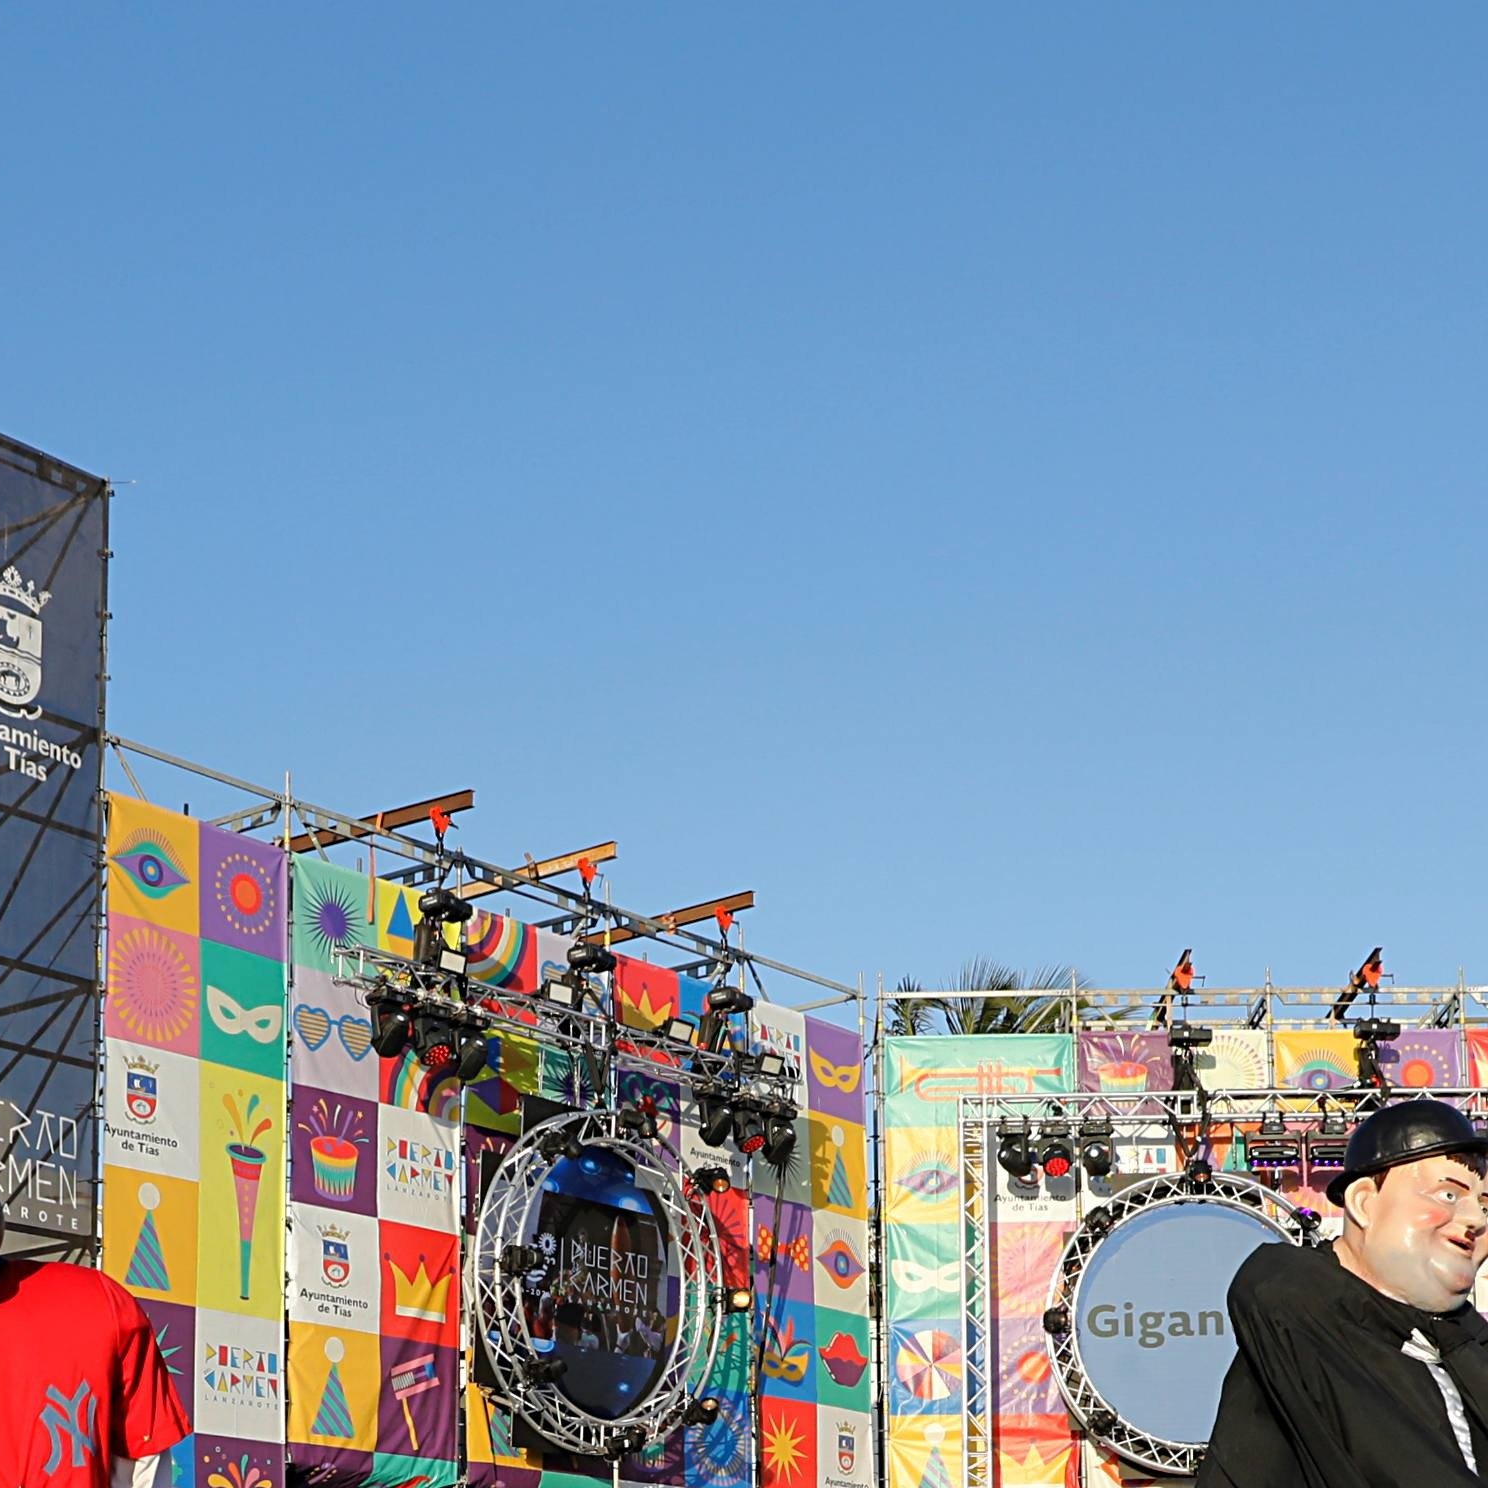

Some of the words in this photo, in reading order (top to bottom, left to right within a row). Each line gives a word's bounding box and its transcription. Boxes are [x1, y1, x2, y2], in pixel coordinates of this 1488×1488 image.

[4, 746, 48, 782] Tías
[104, 1123, 178, 1148] Ayuntamiento
[121, 1139, 134, 1151] de
[690, 1146, 741, 1167] Ayuntamiento
[994, 1193, 1067, 1205] Ayuntamiento
[2, 1203, 78, 1230] AROTE
[571, 1239, 649, 1280] PUERTO
[300, 1288, 369, 1309] Ayuntamiento
[569, 1271, 648, 1307] CARMEN
[318, 1303, 330, 1314] de
[1087, 1303, 1225, 1349] Gigan
